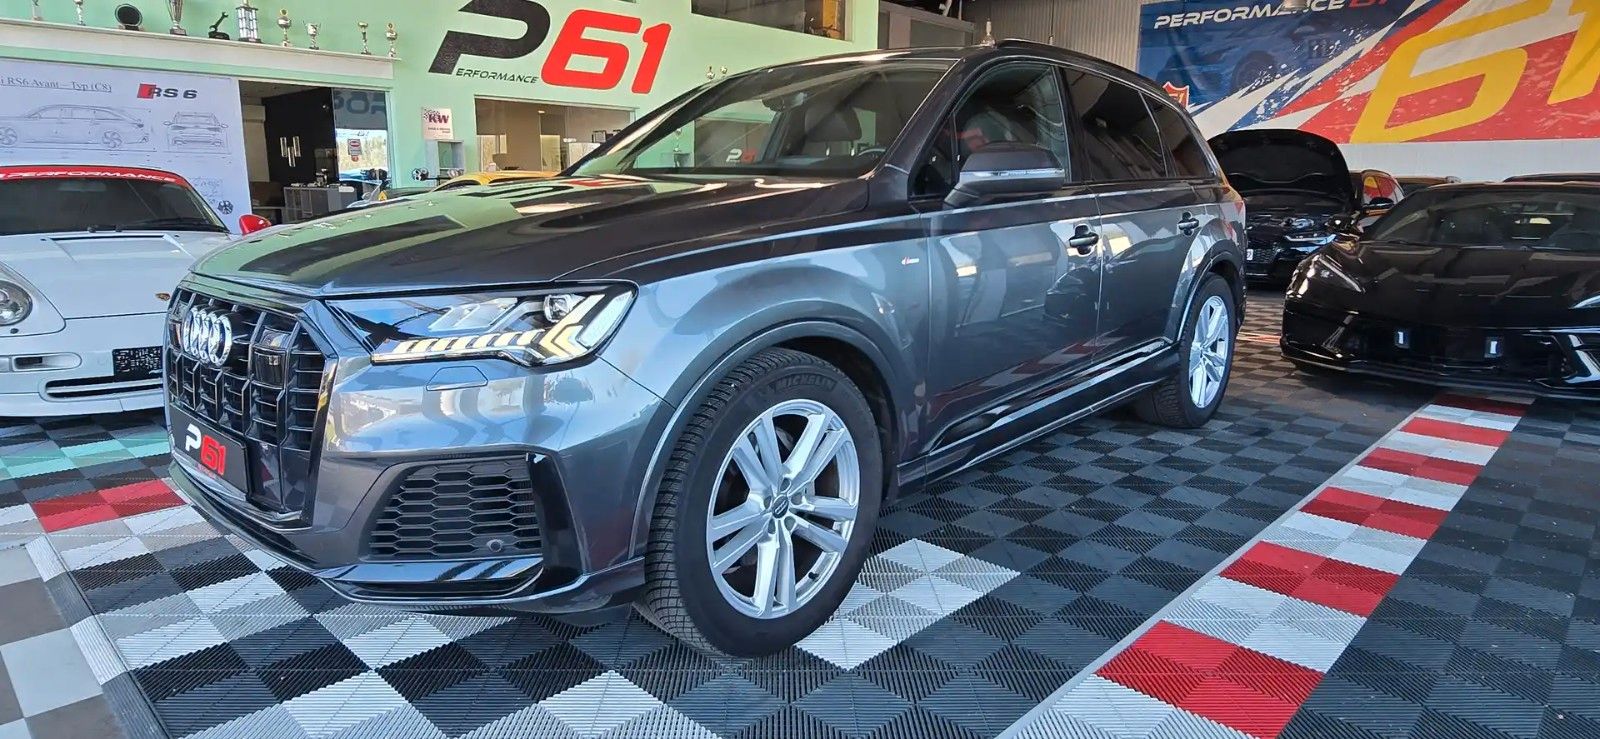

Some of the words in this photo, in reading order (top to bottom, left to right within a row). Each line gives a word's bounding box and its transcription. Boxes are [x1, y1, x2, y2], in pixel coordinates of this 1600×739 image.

[31, 79, 60, 89] Avant
[428, 114, 449, 124] KW
[6, 171, 177, 183] PERFORMANCE
[776, 374, 836, 391] MICHELIN
[185, 422, 226, 476] P61
